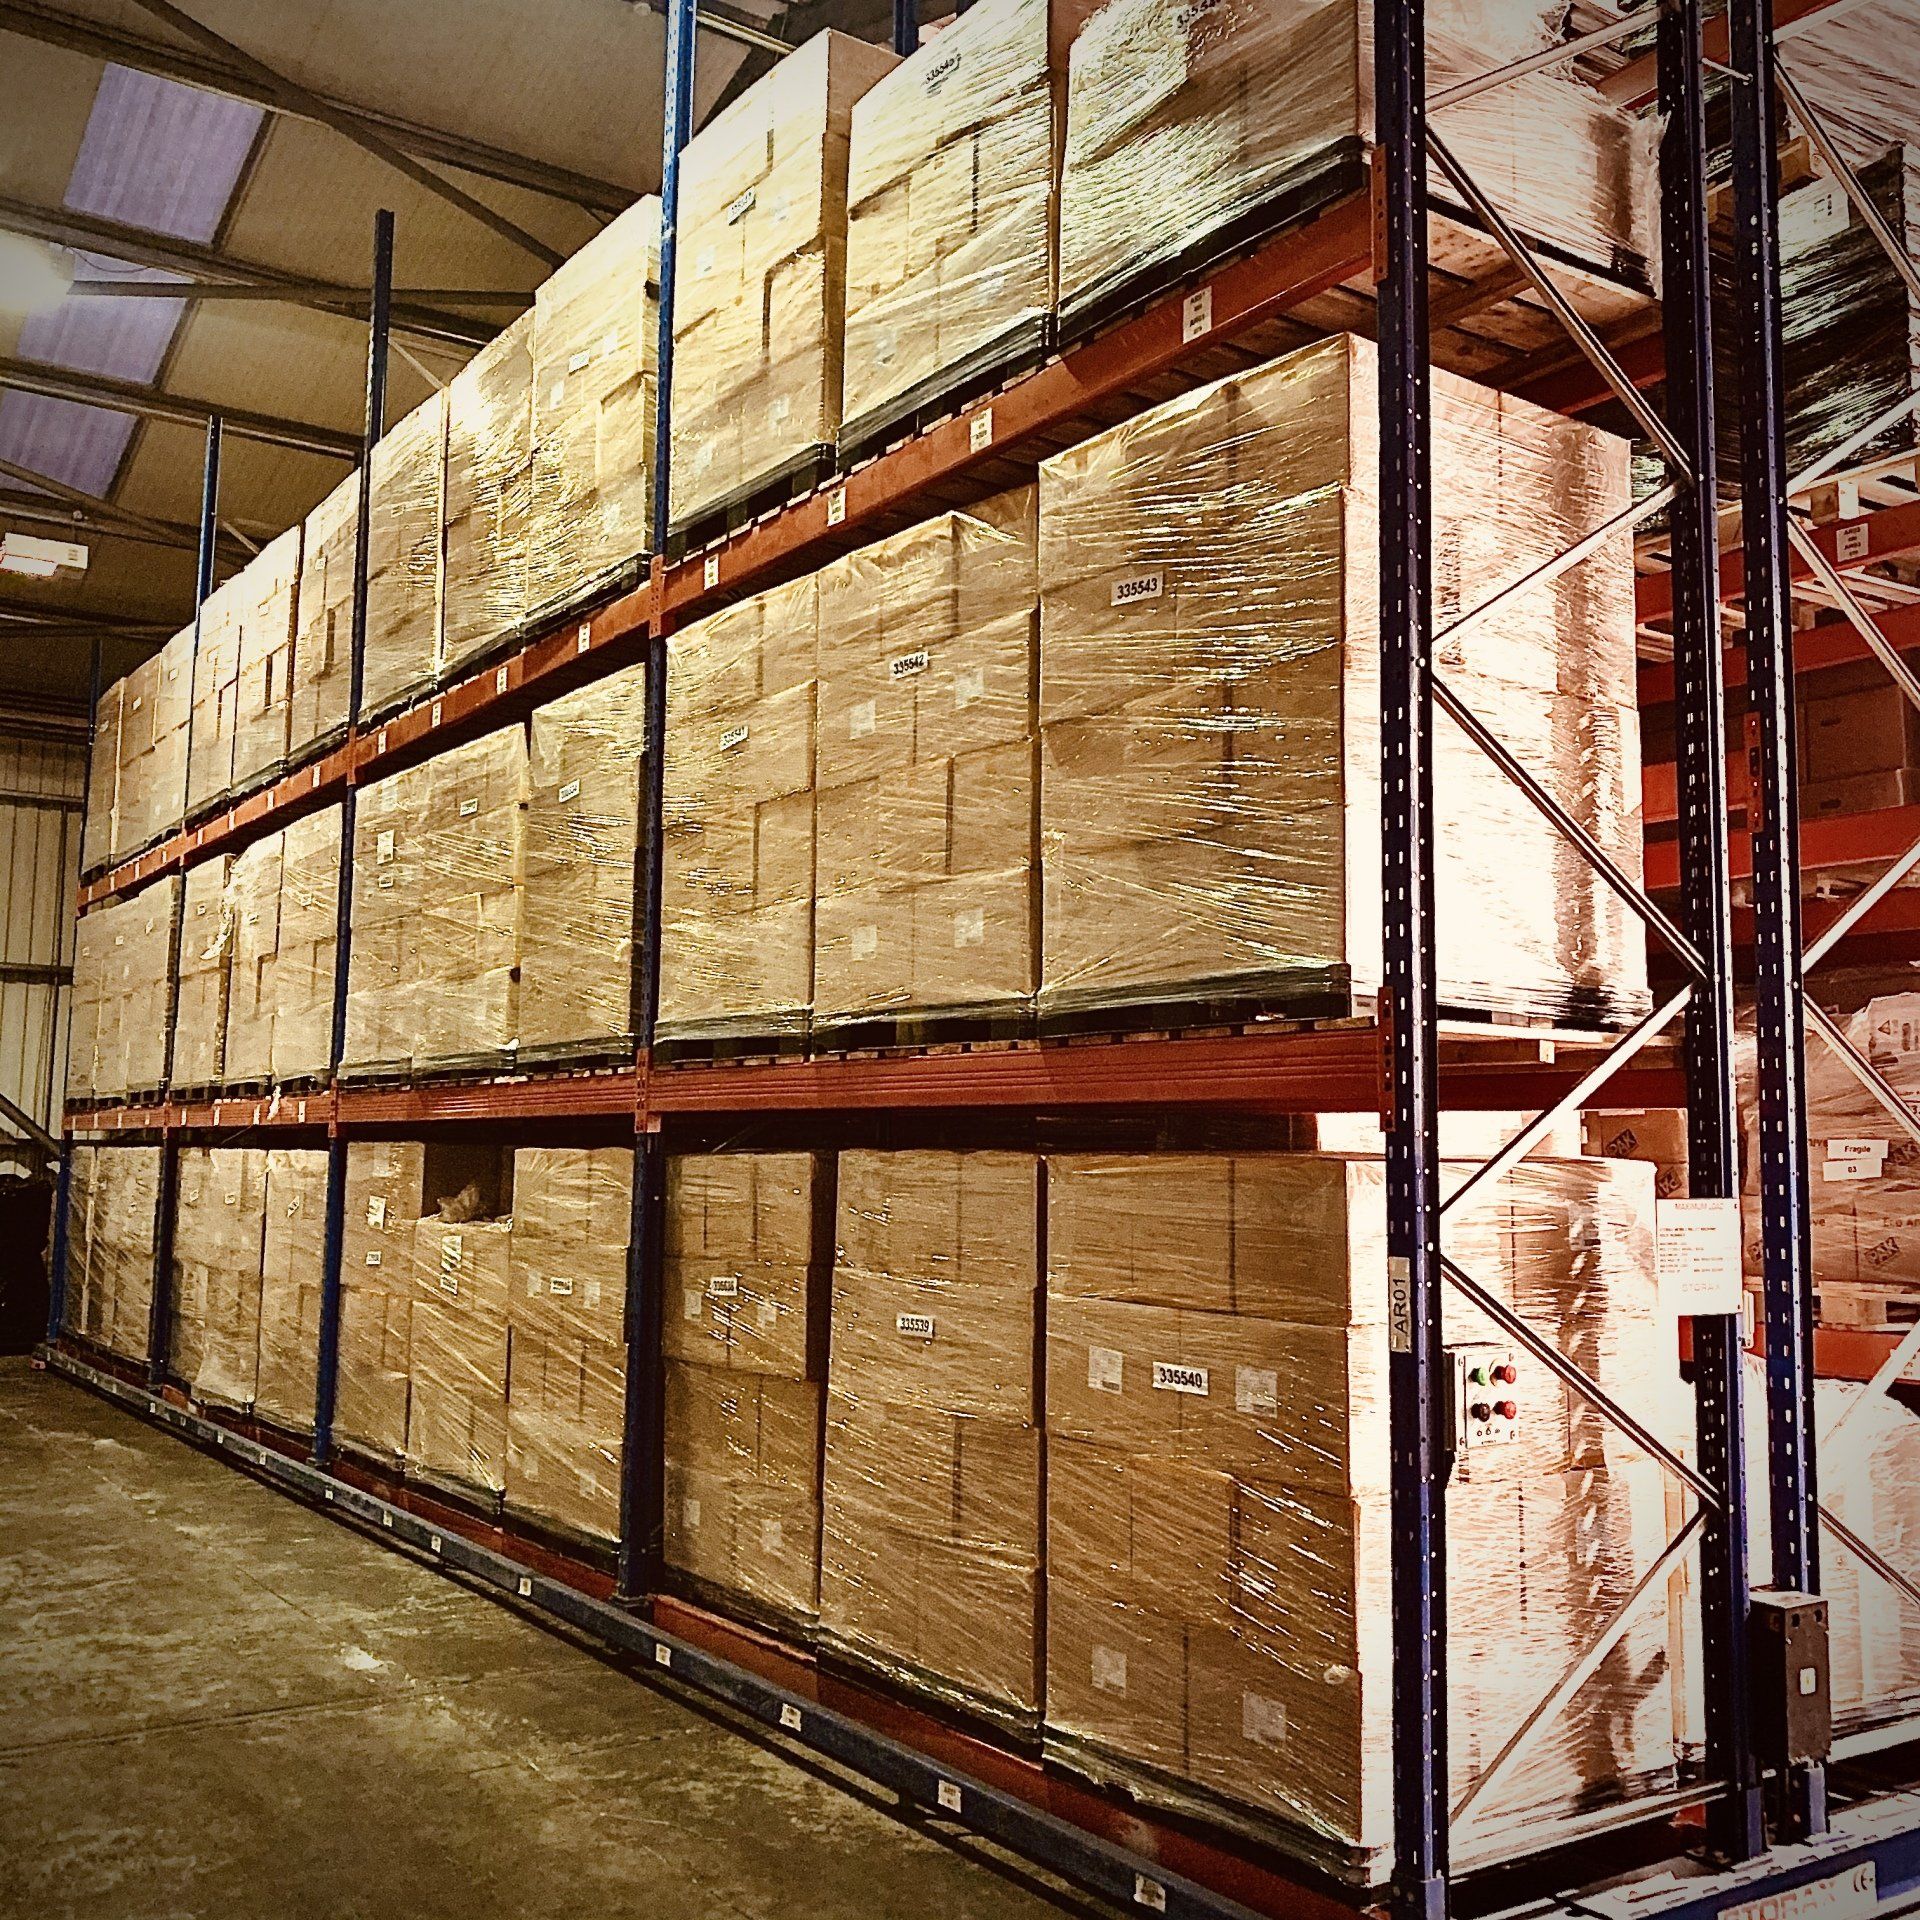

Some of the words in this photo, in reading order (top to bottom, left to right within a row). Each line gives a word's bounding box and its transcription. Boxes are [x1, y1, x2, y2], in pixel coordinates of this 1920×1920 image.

[1117, 578, 1158, 599] 335543
[894, 654, 924, 675] 335542
[1844, 1145, 1871, 1155] Fragile
[1392, 1278, 1409, 1335] AR01
[900, 1317, 930, 1333] 335539
[1160, 1367, 1203, 1389] 335540
